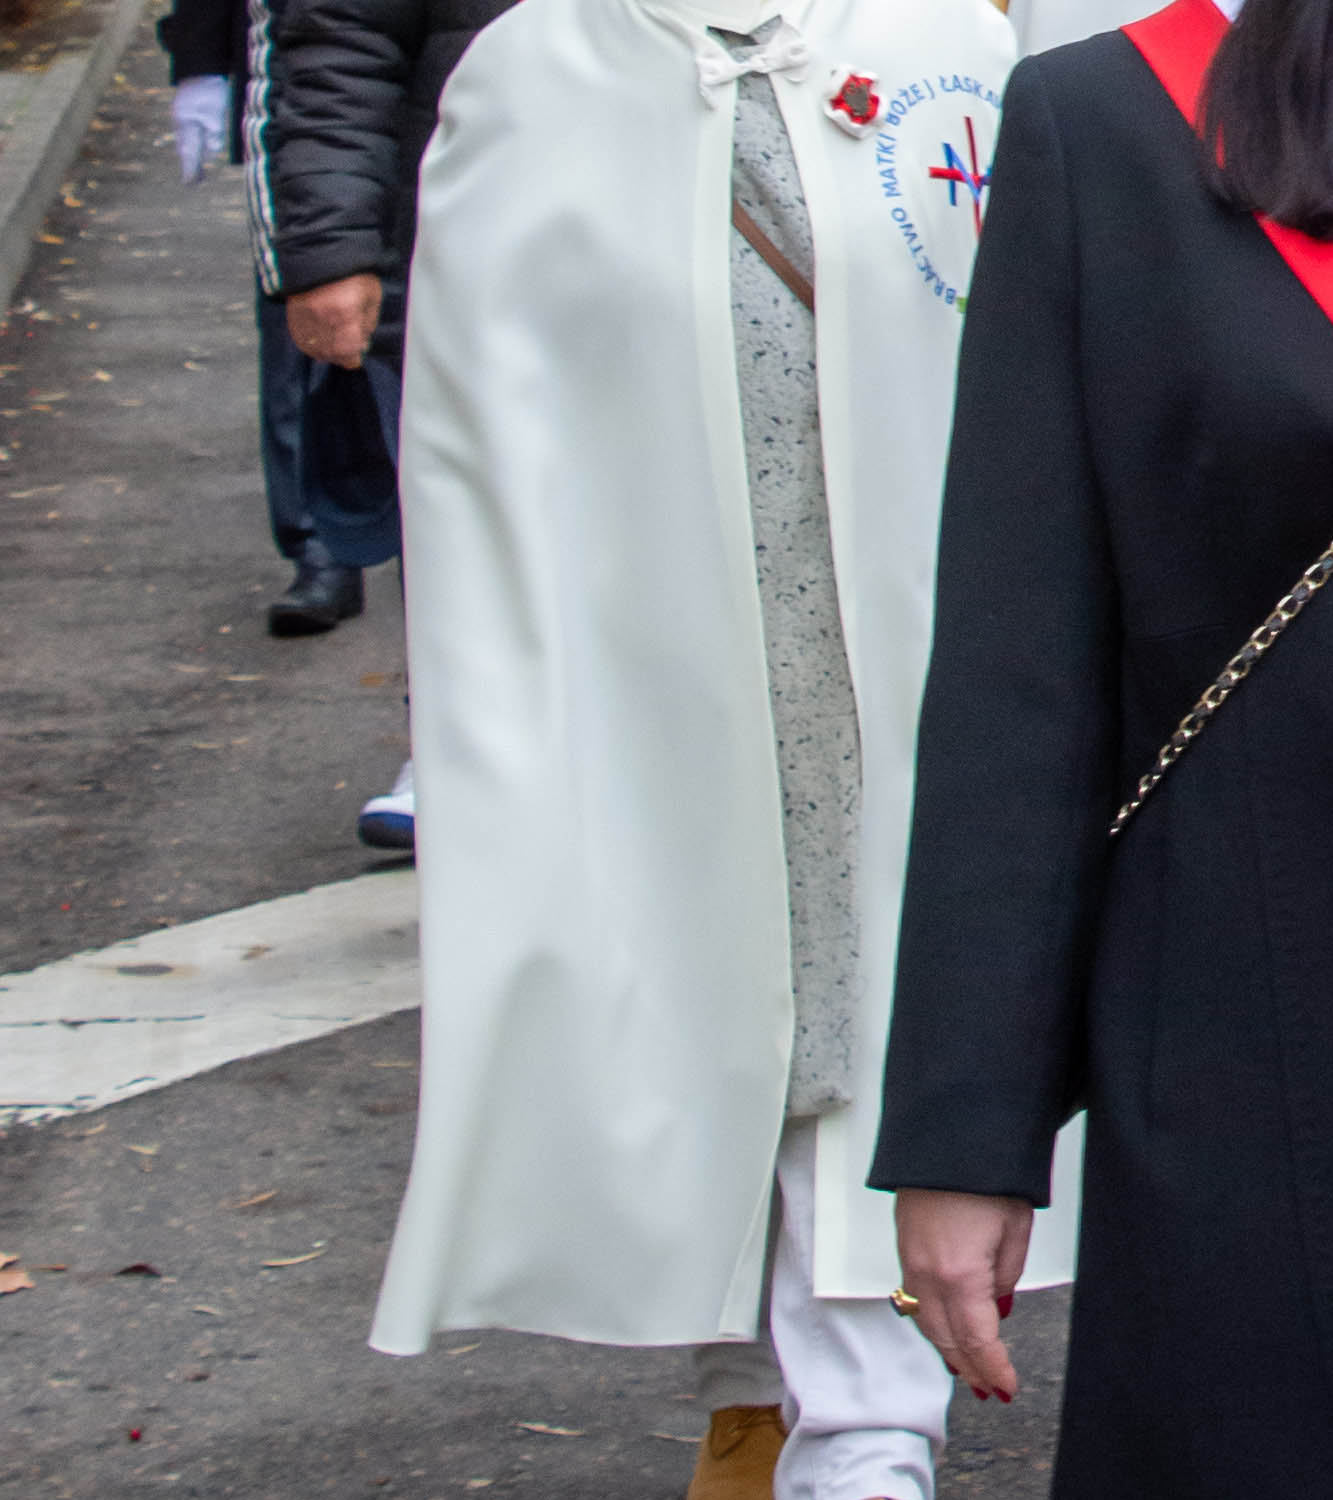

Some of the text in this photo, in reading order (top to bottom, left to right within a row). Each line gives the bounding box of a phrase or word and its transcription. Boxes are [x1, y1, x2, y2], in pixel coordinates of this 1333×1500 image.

[885, 78, 936, 127] BOŻEJ
[876, 132, 903, 197] MATKI
[890, 206, 957, 305] BRACTWO
